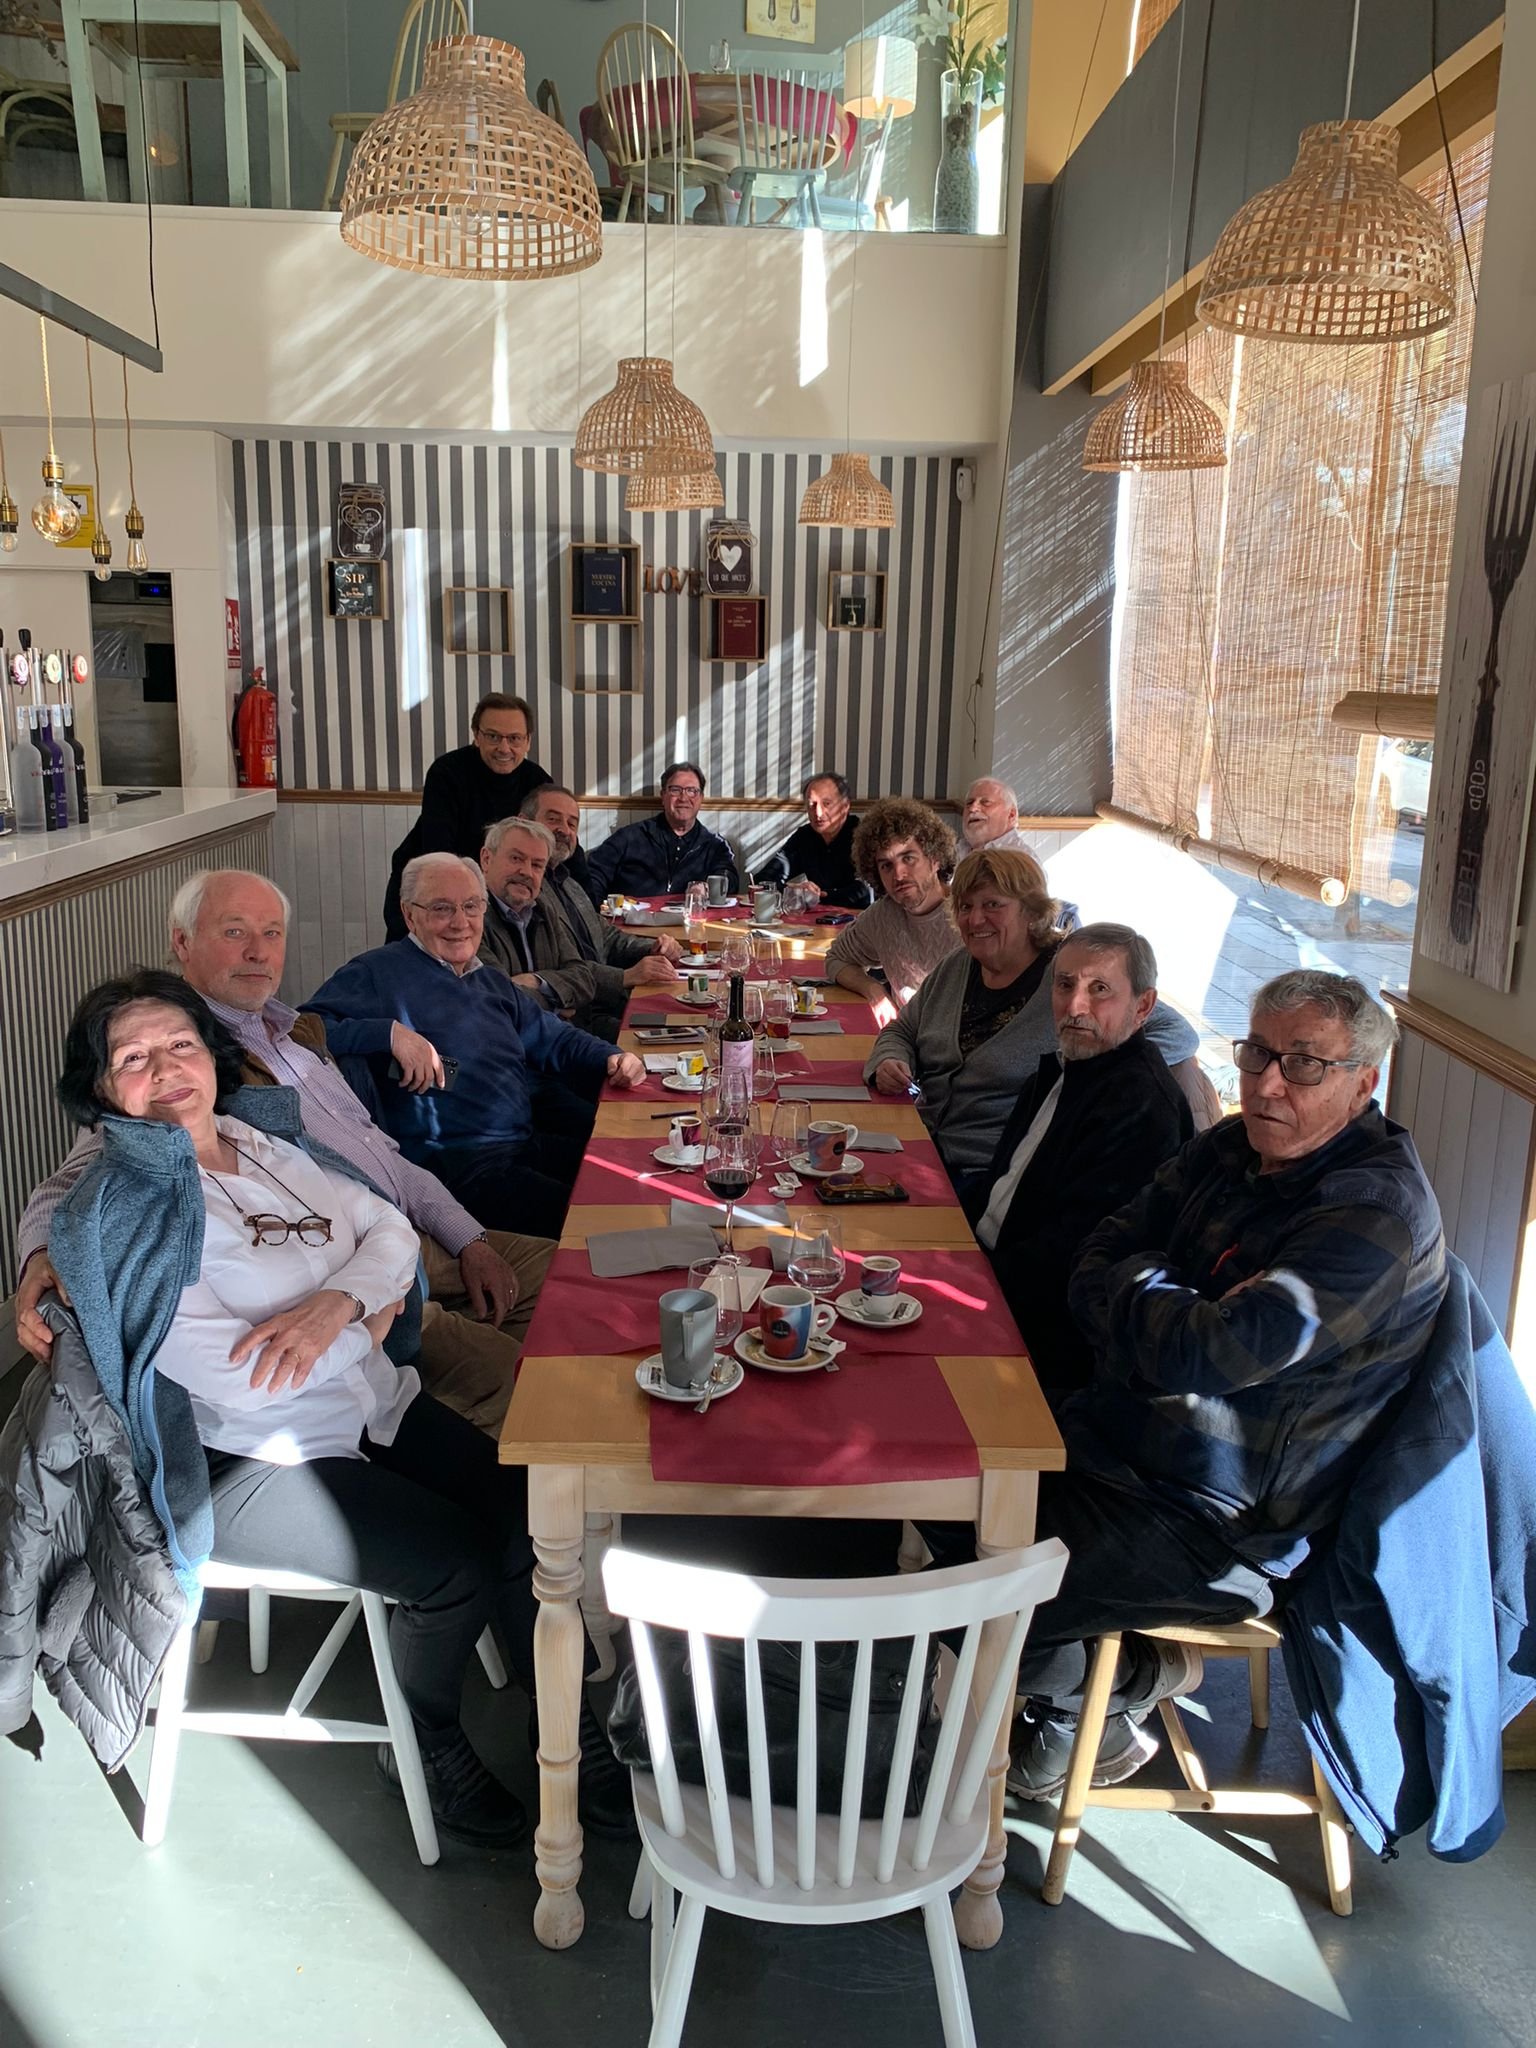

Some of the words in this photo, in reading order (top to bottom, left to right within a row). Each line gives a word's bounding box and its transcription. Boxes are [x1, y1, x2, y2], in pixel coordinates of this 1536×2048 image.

[345, 573, 365, 584] SIP
[644, 565, 704, 597] LOVE
[1468, 759, 1486, 811] GOOD
[1457, 848, 1480, 909] FEEL
